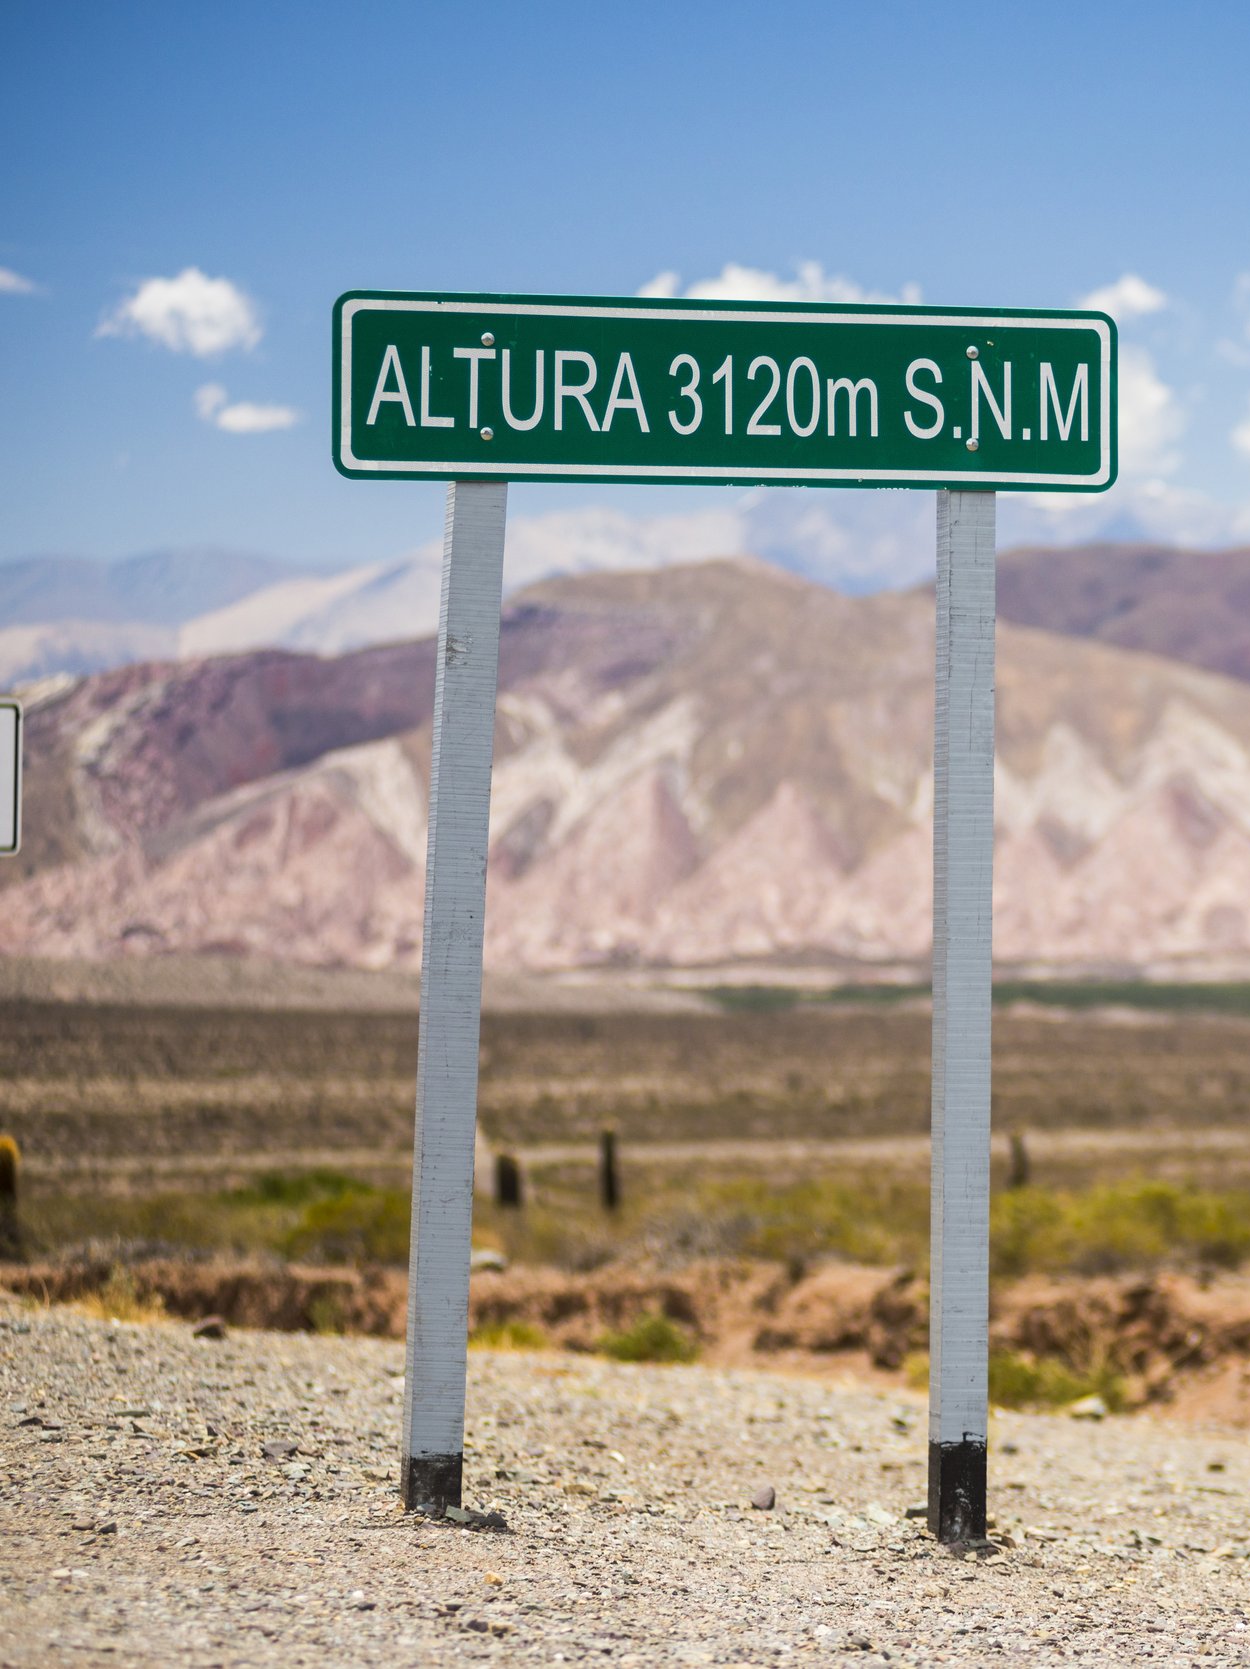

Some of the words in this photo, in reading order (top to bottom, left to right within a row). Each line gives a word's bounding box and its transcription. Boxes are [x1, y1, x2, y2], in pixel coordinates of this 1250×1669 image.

[366, 344, 651, 433] ALTURA
[667, 353, 879, 437] 3120m
[903, 358, 1089, 442] S.N.M
